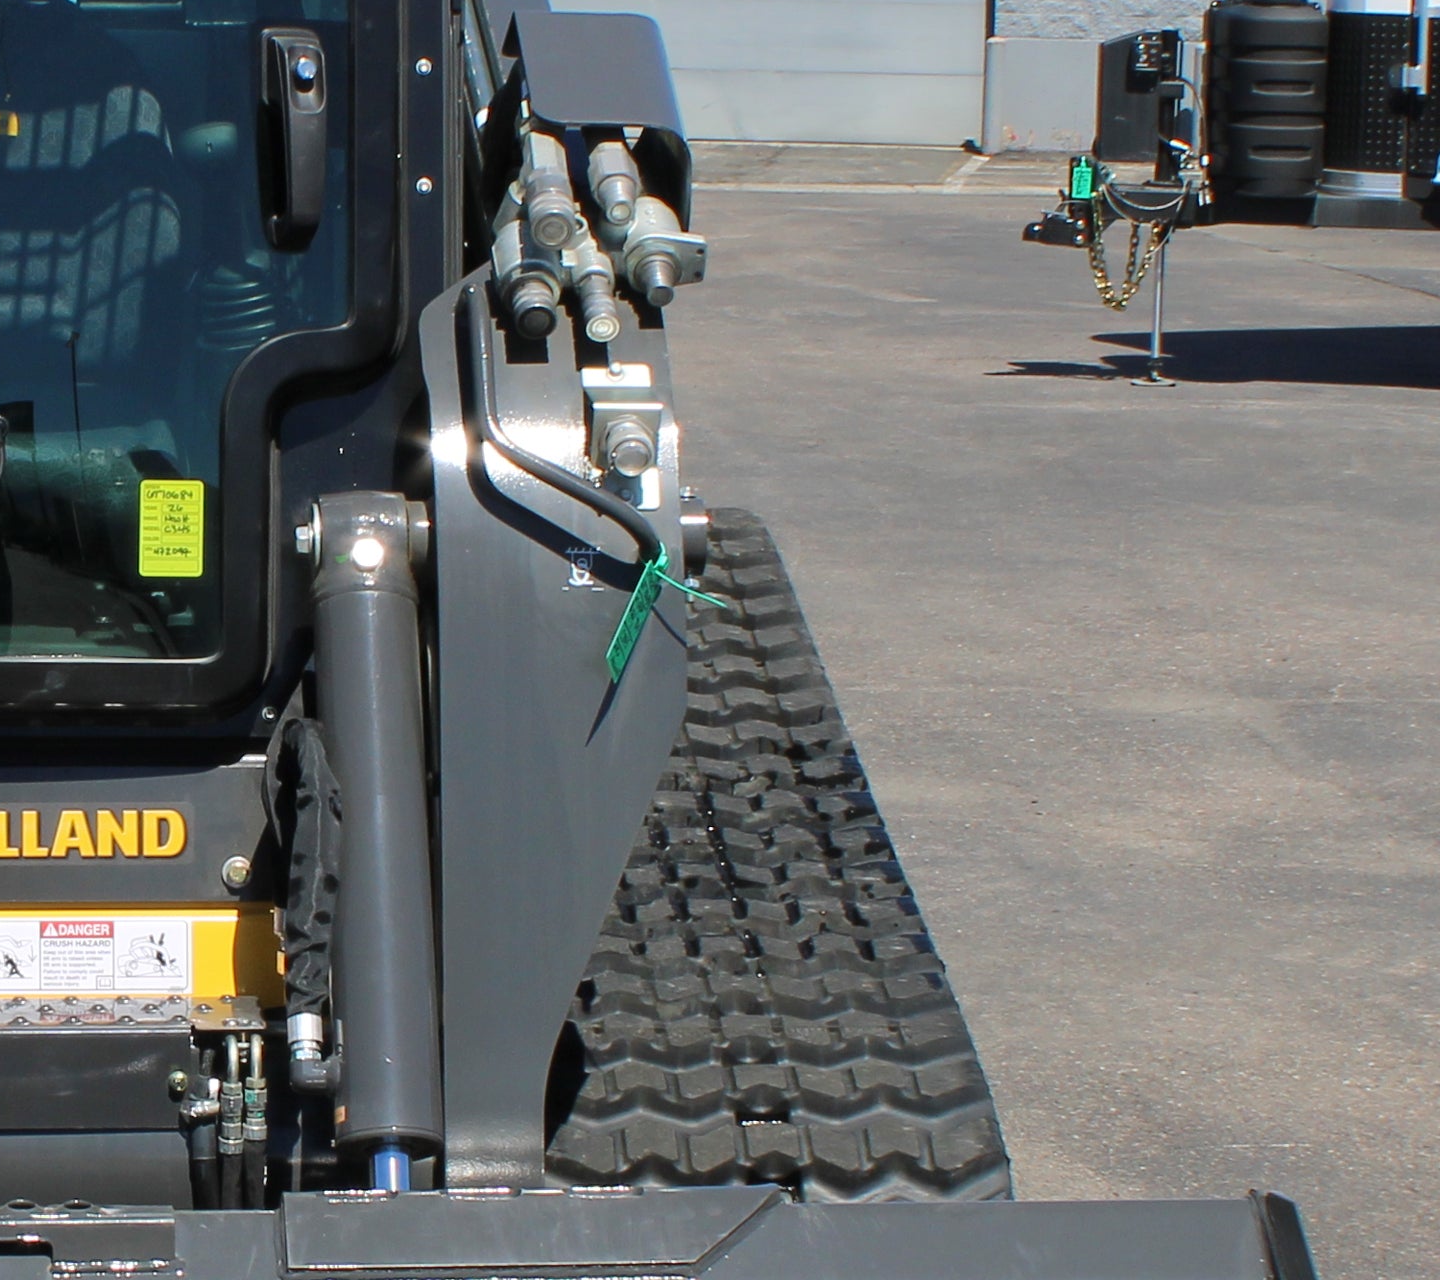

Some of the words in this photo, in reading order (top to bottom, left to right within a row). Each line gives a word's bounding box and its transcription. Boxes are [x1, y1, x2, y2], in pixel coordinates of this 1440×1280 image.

[58, 924, 110, 936] DANGER
[43, 940, 73, 948] CRUSH
[76, 940, 111, 948] HAZARD
